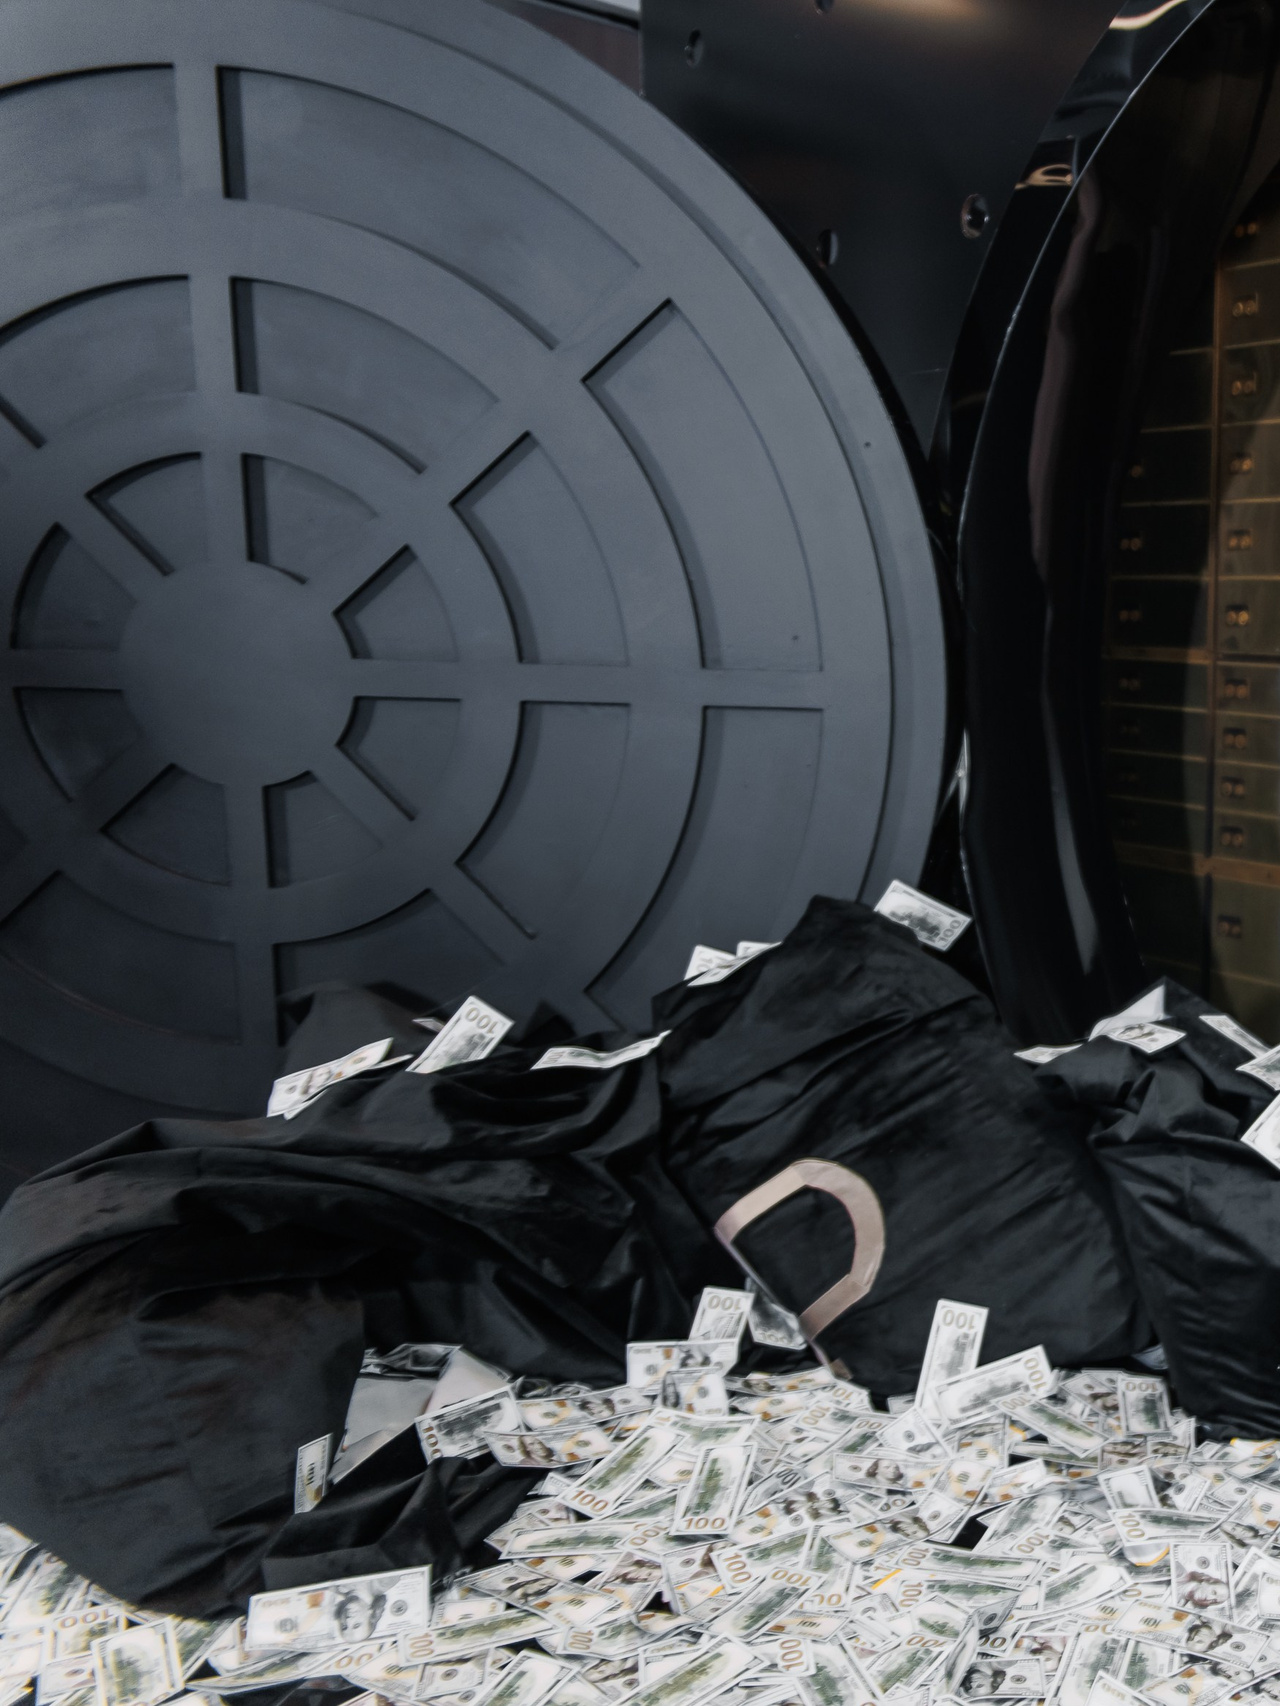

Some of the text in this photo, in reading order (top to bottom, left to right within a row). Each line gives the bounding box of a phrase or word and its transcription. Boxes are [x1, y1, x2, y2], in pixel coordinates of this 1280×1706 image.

[937, 919, 961, 945] 100
[464, 1006, 500, 1035] 100
[708, 1294, 742, 1312] 100
[942, 1308, 977, 1331] 100
[1023, 1357, 1047, 1392] 100
[1125, 1380, 1159, 1393] 100
[803, 1404, 831, 1425] 100
[857, 1419, 883, 1430] 00
[569, 1488, 611, 1514] 100
[629, 1522, 668, 1547] 100
[684, 1516, 725, 1531] 100
[1118, 1512, 1146, 1540] 100
[1016, 1531, 1051, 1555] 100
[723, 1551, 752, 1584] 100
[901, 1547, 931, 1567] 100
[771, 1568, 812, 1588] 100
[899, 1581, 923, 1608] 100
[58, 1609, 111, 1630] 100
[409, 1631, 434, 1659] 100
[569, 1629, 595, 1651] 100
[906, 1634, 946, 1648] 100
[979, 1635, 1007, 1650] 00
[778, 1638, 804, 1671] 100
